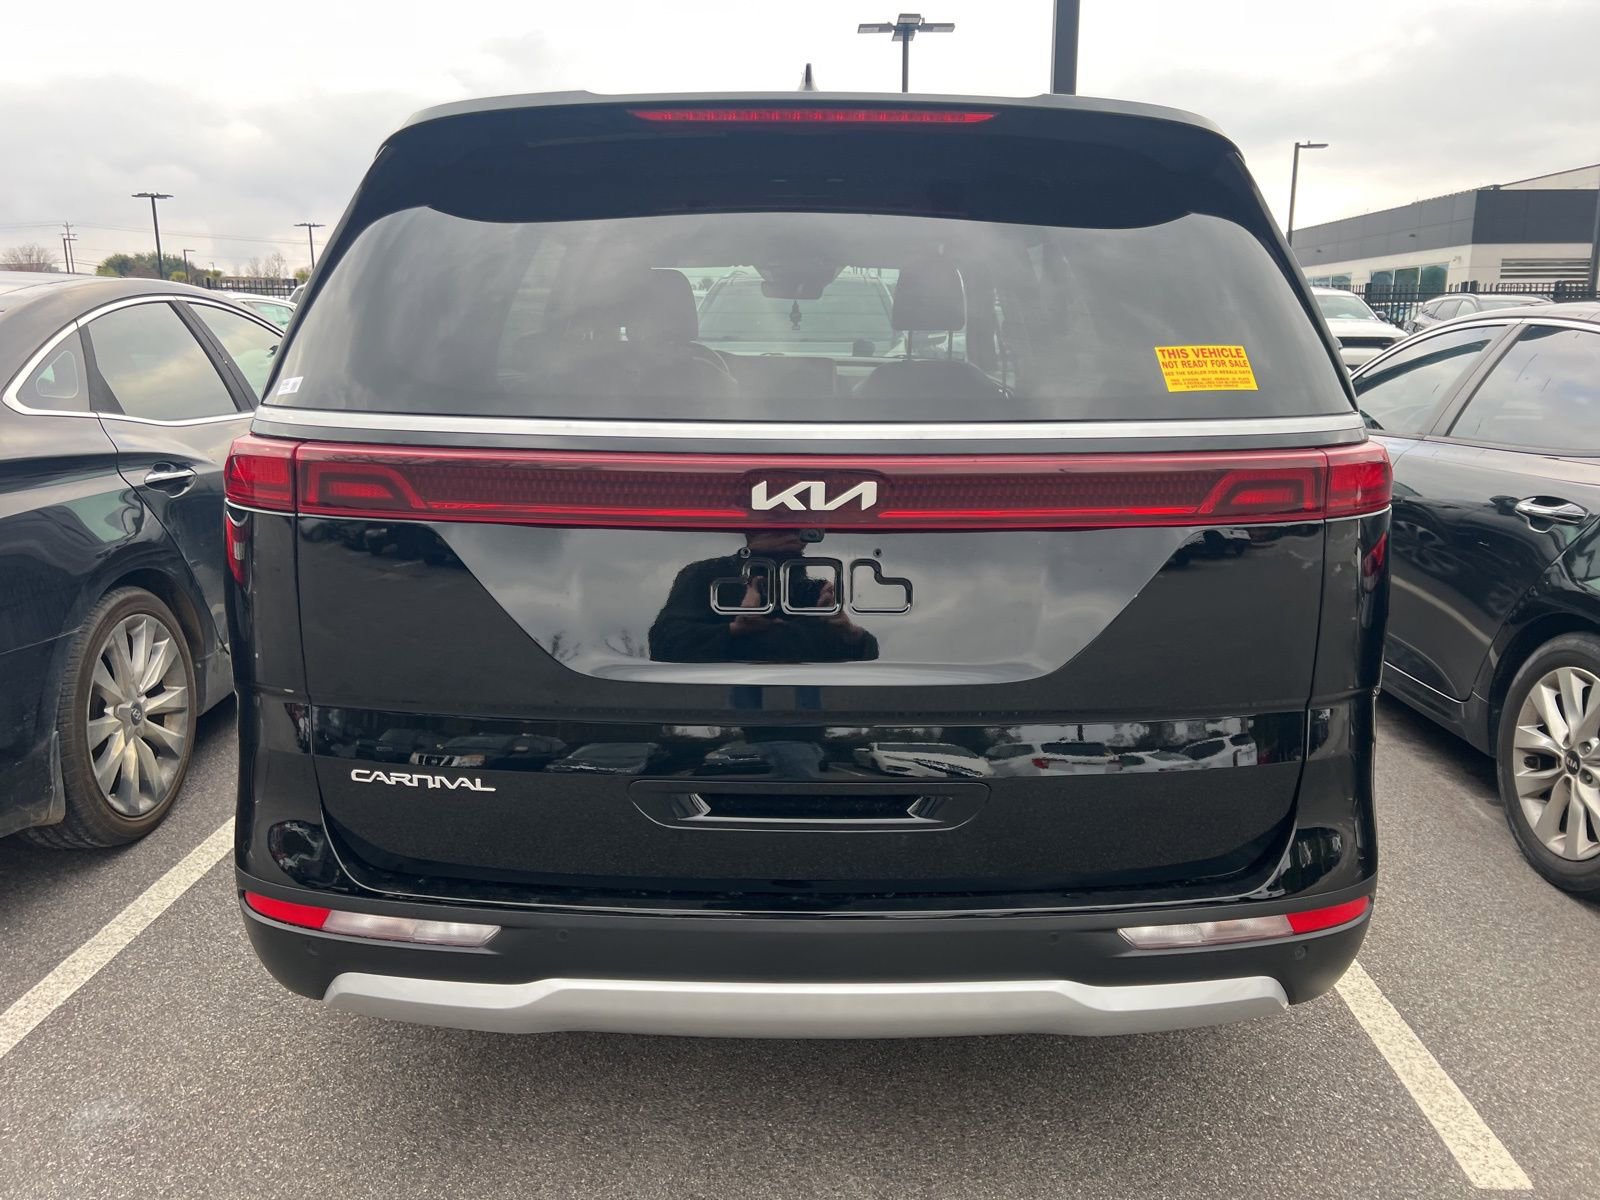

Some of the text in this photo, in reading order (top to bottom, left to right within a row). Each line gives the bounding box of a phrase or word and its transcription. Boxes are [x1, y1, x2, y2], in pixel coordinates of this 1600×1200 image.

[1159, 348, 1244, 359] THIS VEHICLE
[1161, 359, 1248, 369] NOT READY FOR SALE
[751, 480, 878, 510] KIA
[1566, 756, 1578, 770] KIA
[350, 769, 496, 792] CARNIVAL
